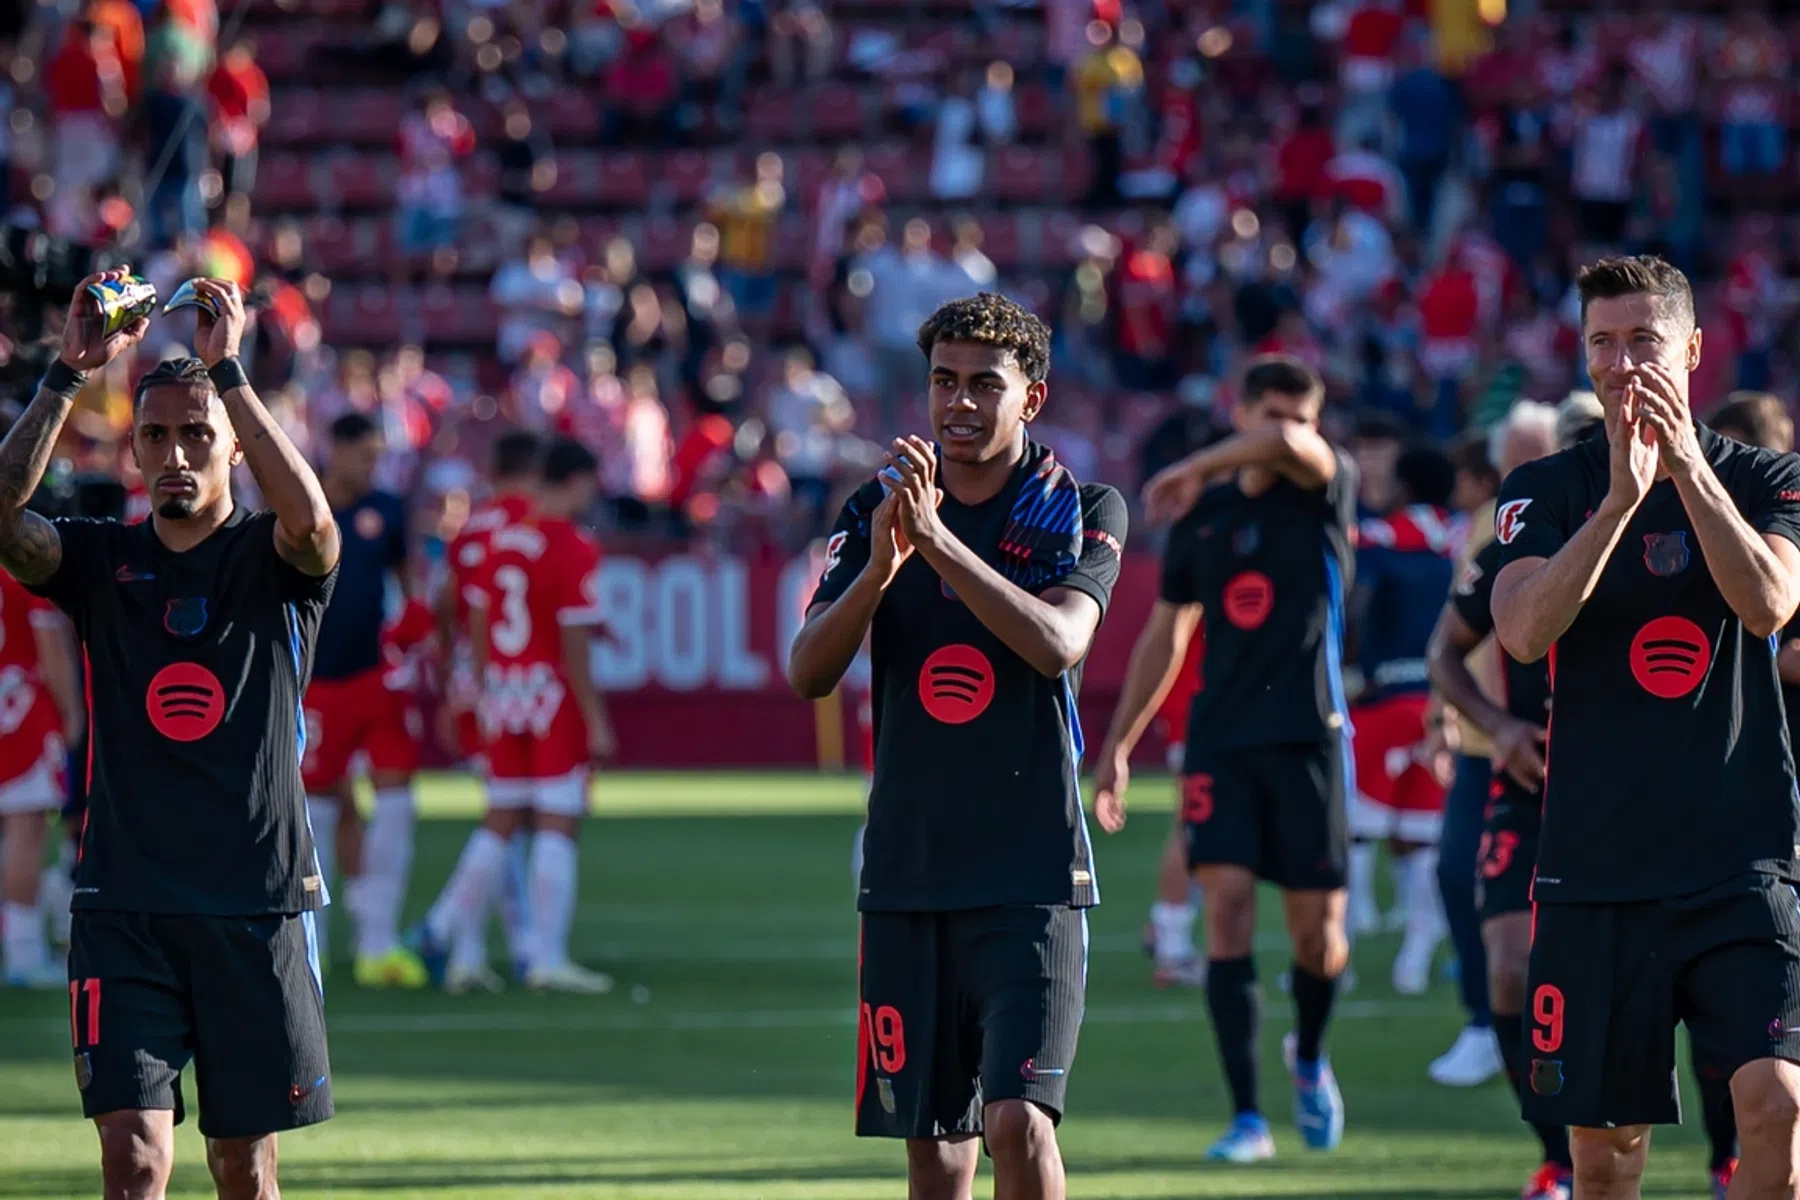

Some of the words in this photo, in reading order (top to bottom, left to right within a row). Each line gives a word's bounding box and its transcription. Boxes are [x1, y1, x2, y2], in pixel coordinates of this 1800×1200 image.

[491, 564, 533, 657] 3
[69, 978, 101, 1048] 11
[864, 1002, 906, 1073] 19
[1532, 983, 1565, 1053] 9
